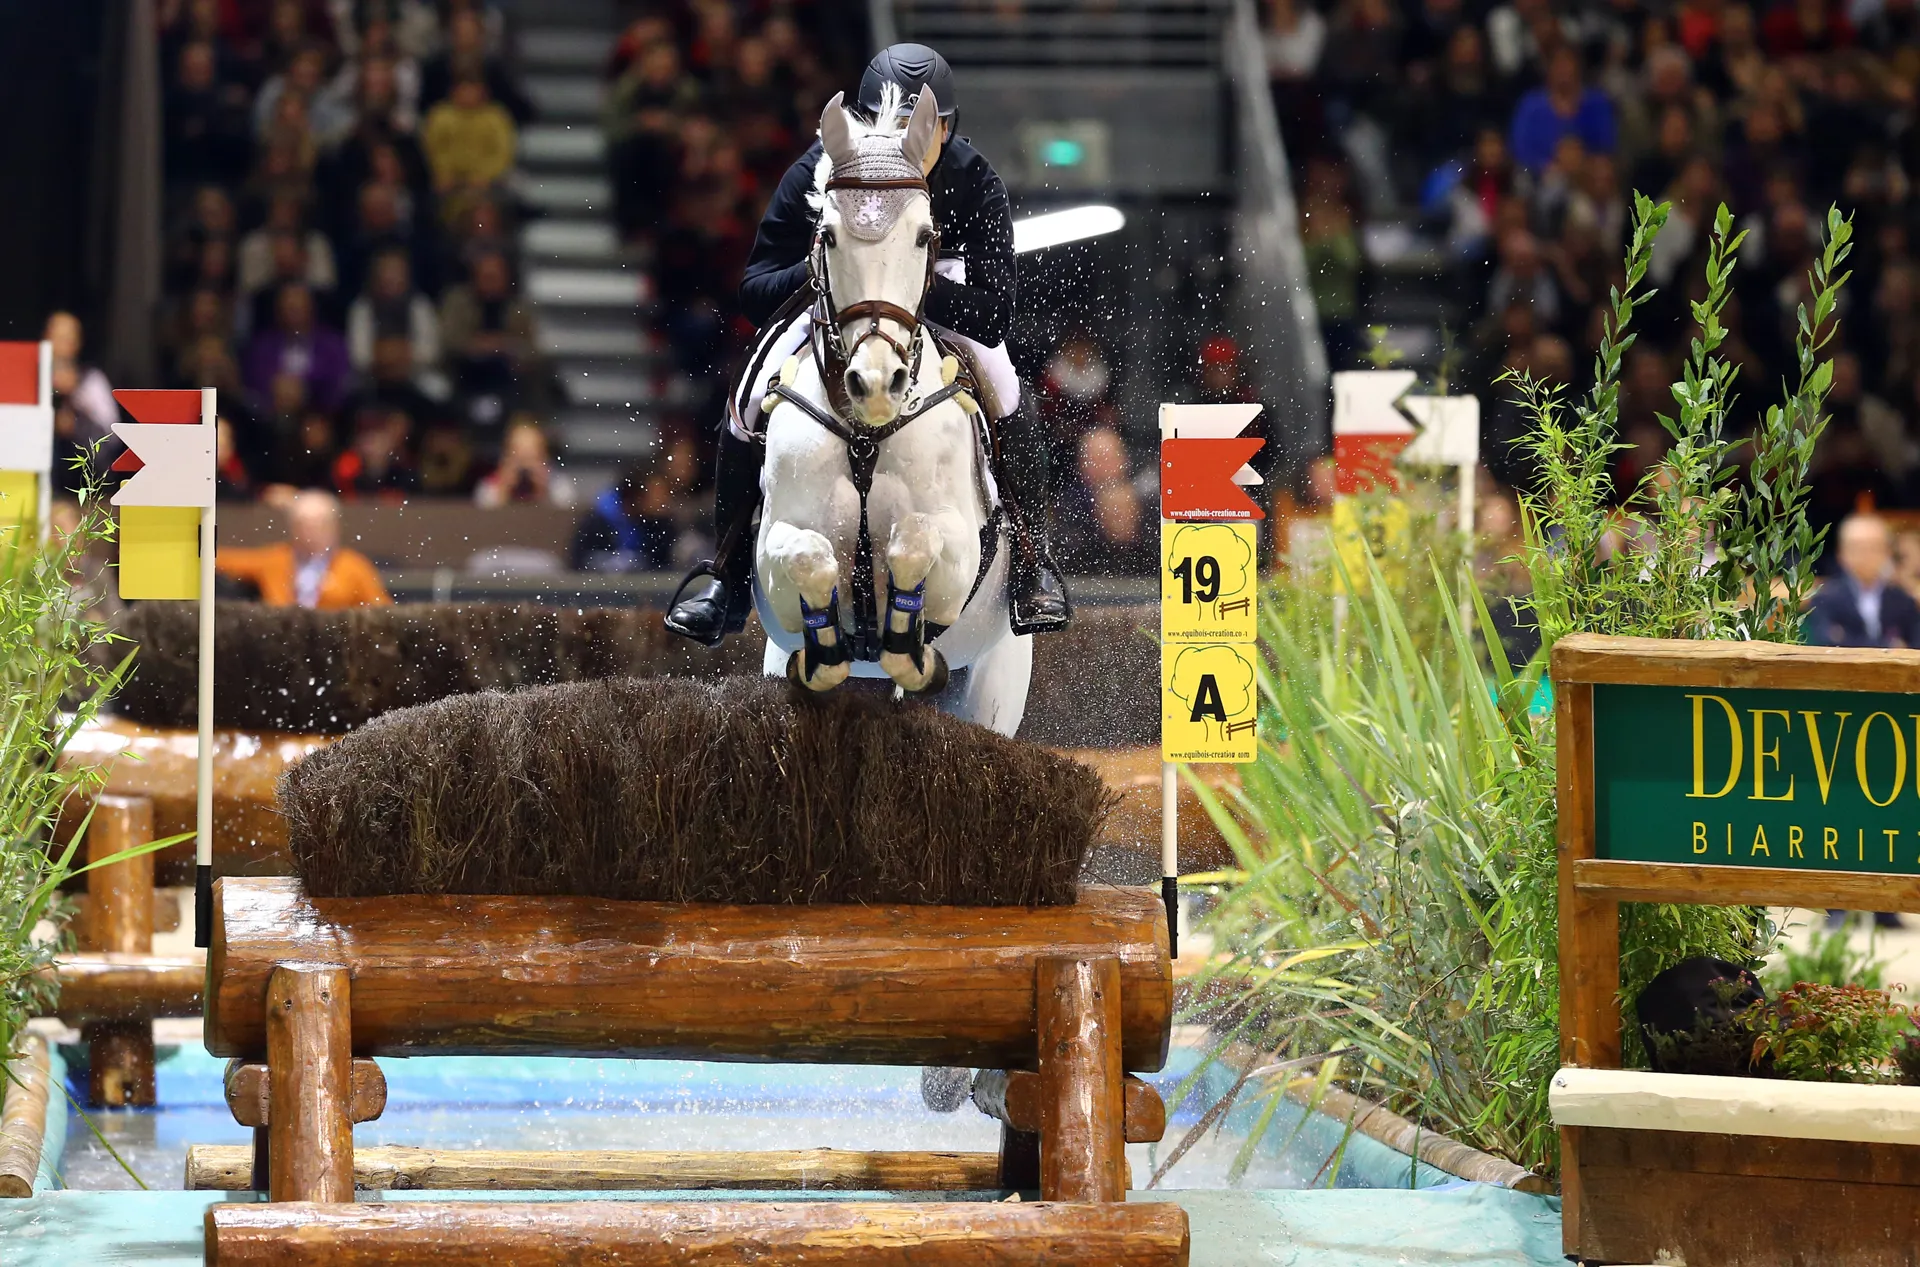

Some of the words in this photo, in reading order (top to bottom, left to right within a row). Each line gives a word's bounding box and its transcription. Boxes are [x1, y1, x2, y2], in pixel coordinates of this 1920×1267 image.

[1170, 508, 1251, 519] www.equibois-creation.com
[1173, 555, 1221, 604] 19
[1189, 674, 1228, 723] A
[1692, 821, 1920, 864] BIARRIT
